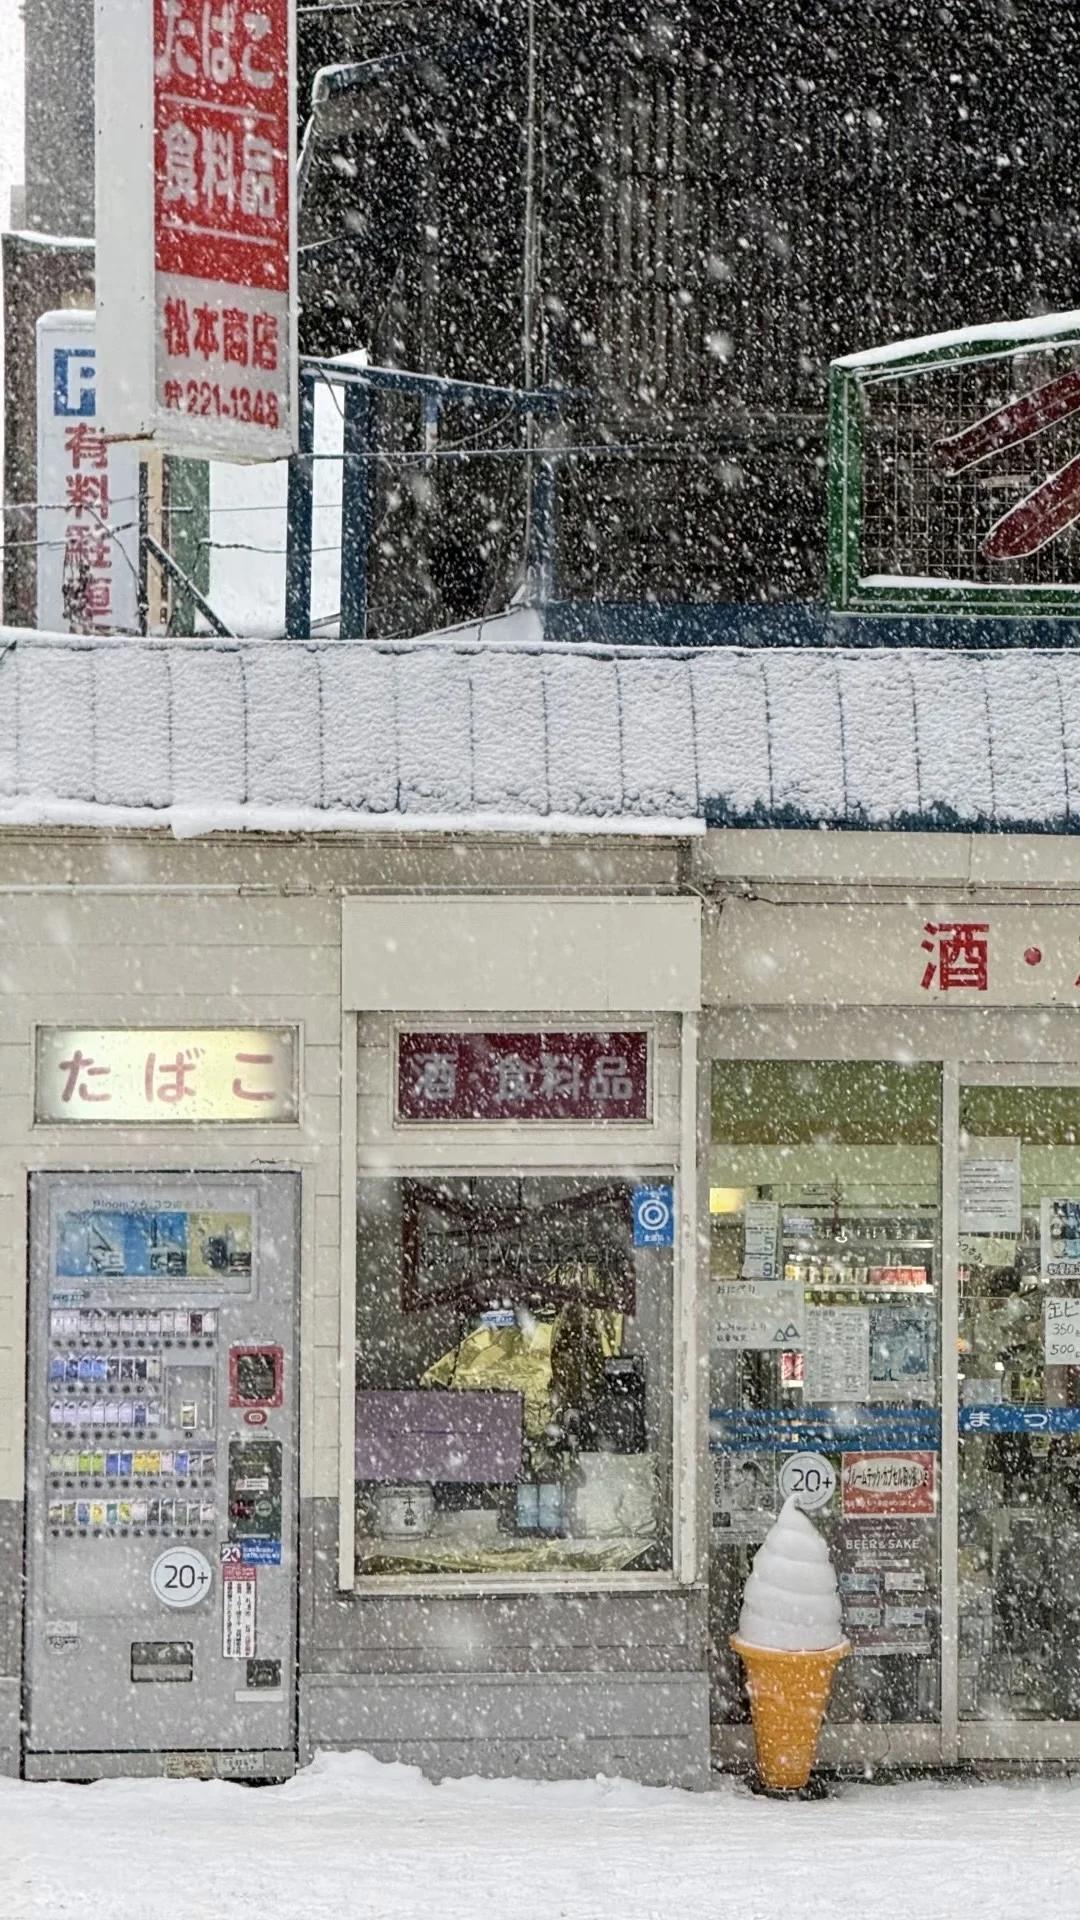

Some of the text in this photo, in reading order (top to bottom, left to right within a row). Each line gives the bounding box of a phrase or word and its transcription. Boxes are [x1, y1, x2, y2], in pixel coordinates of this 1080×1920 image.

[155, 0, 275, 89] たばこ
[162, 120, 277, 219] 食料品
[164, 296, 278, 370] 松本商店
[62, 422, 112, 636] 有料駐車
[921, 923, 1080, 990] 酒・
[59, 1048, 278, 1103] たばこ
[412, 1053, 633, 1101] 酒・食料品
[791, 1468, 833, 1492] 20+
[164, 1564, 209, 1589] 20+
